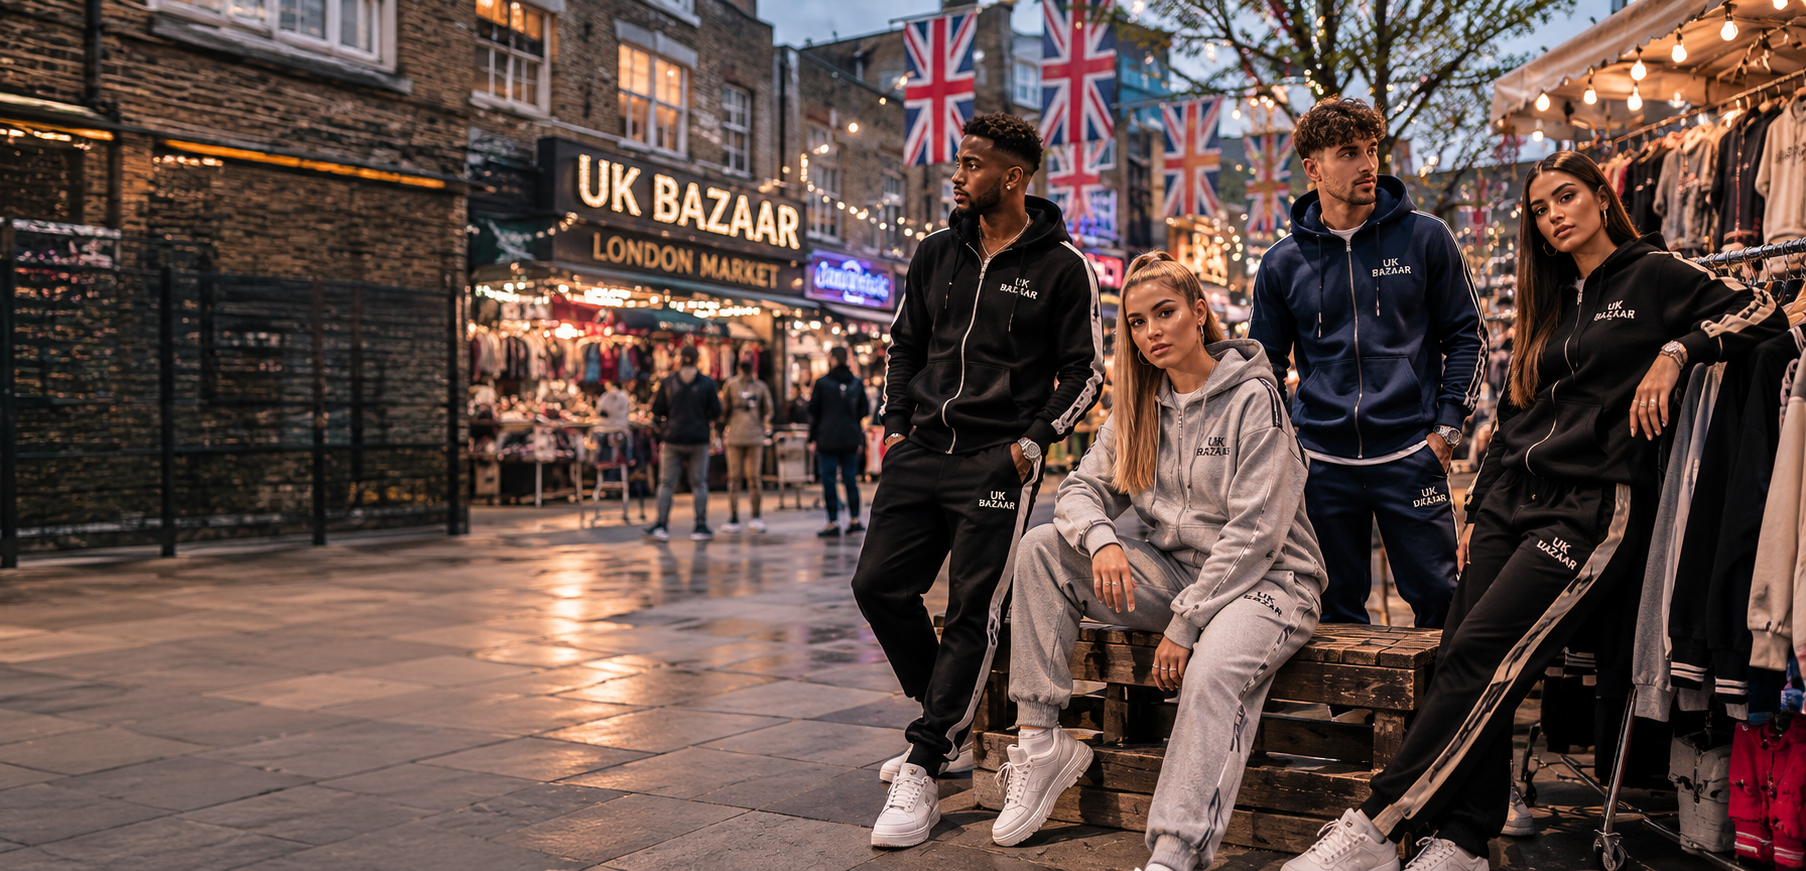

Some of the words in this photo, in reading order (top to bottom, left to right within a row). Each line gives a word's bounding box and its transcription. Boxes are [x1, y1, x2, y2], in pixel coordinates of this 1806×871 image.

[579, 154, 642, 217] UK
[653, 173, 800, 250] BAZAAR
[593, 232, 694, 275] LONDON
[699, 252, 780, 289] MARKET
[1382, 257, 1399, 267] UK
[1371, 265, 1412, 278] BAZAAR
[1015, 277, 1030, 289] UK
[1607, 299, 1624, 311] UK
[1207, 436, 1226, 447] UK
[990, 490, 1006, 501] UK
[1421, 486, 1438, 498] UK
[978, 498, 1016, 510] BAZAAR
[1552, 536, 1572, 555] UK
[1257, 591, 1276, 605] UK
